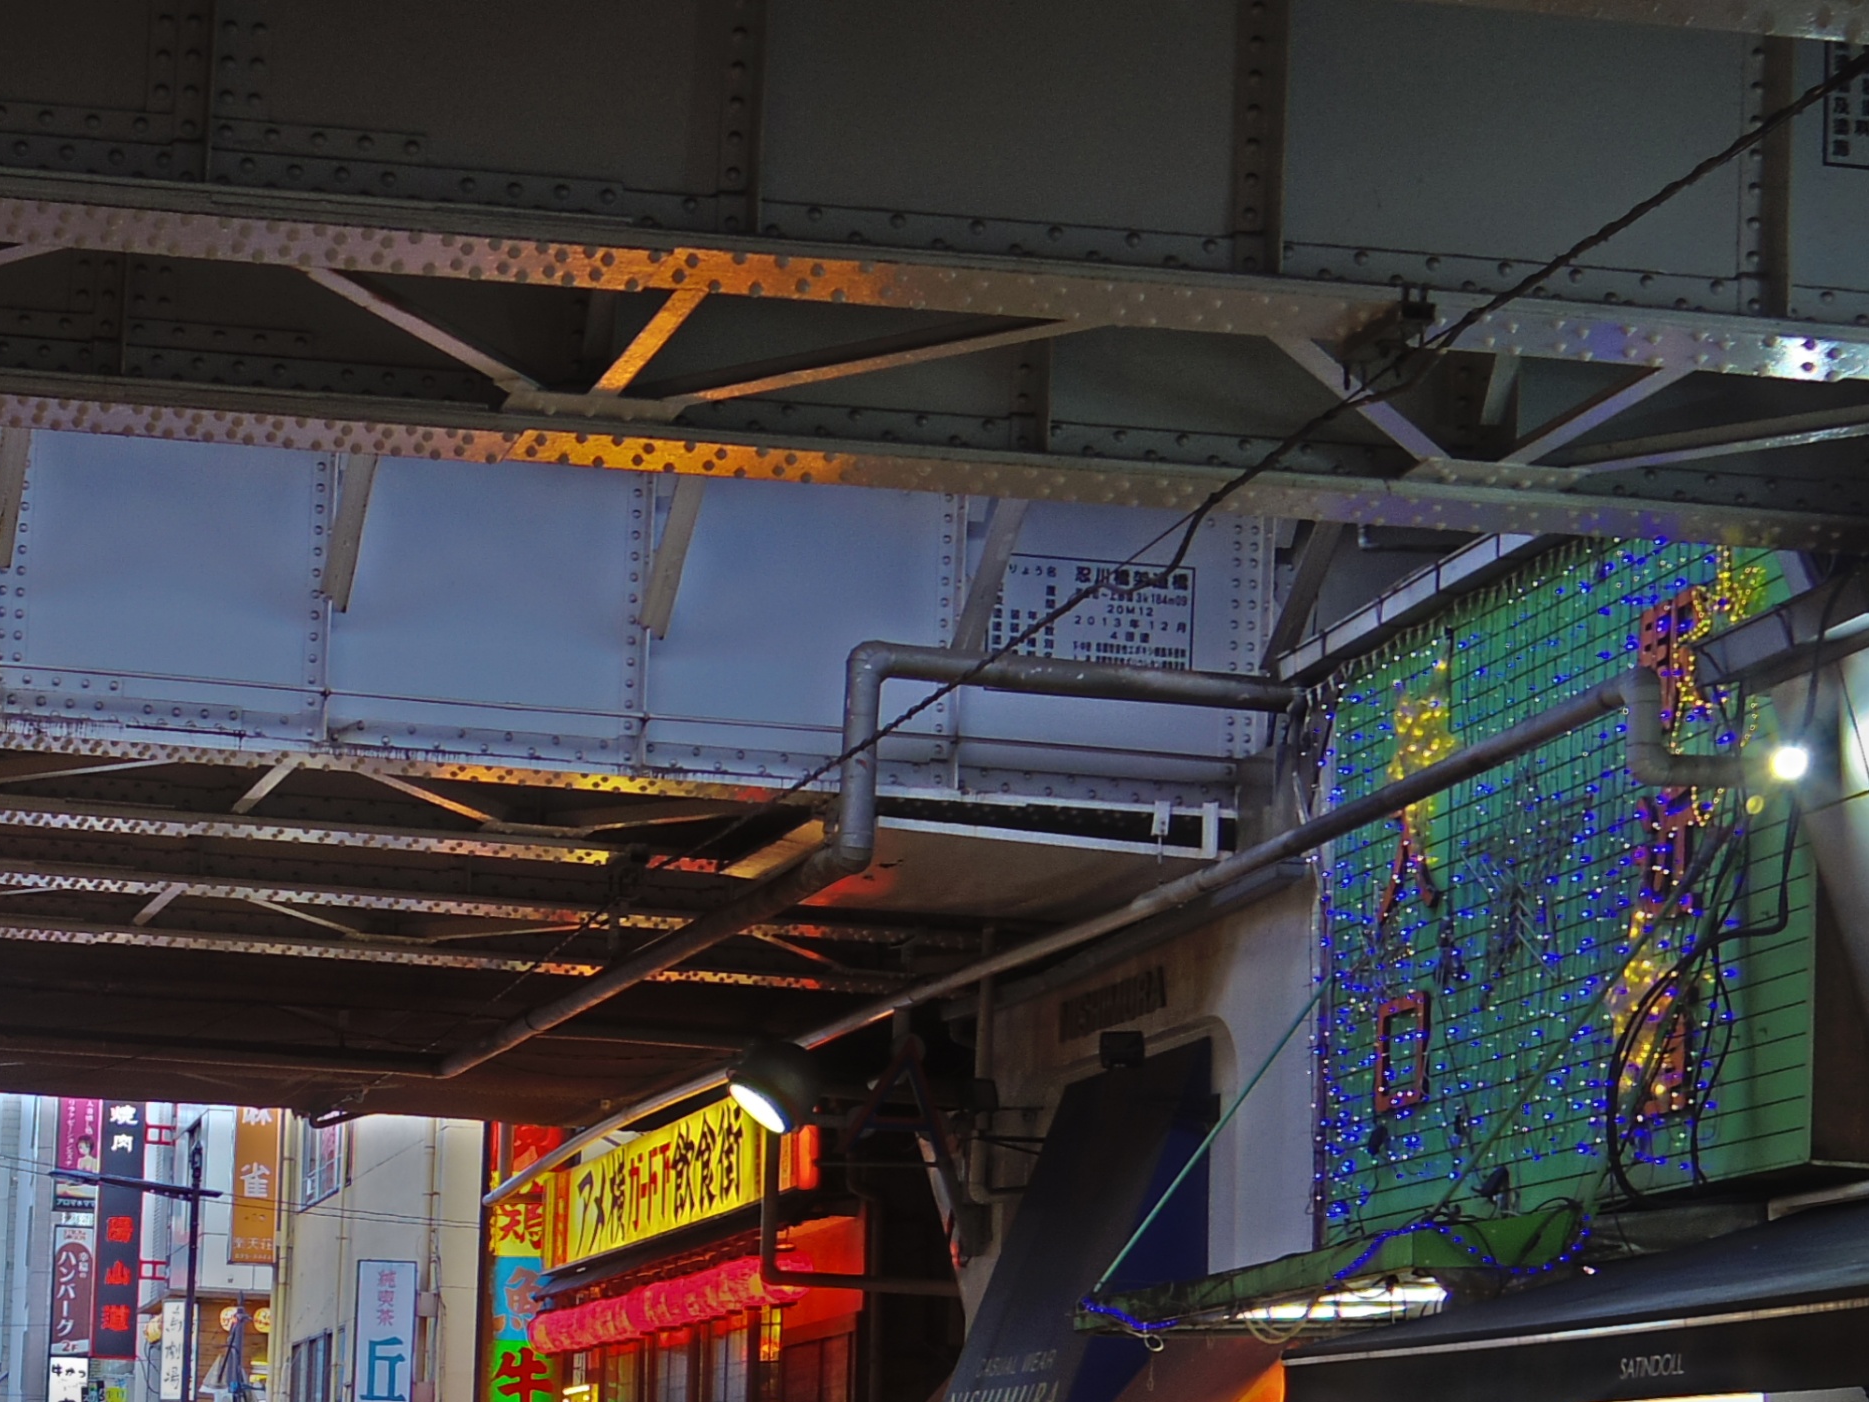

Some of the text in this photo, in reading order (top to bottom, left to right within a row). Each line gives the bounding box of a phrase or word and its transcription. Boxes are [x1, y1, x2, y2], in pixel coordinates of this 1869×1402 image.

[110, 1105, 138, 1153] 焼肉
[57, 1251, 77, 1337] ハンバーグ
[376, 1270, 397, 1326] 純喫茶
[61, 1340, 79, 1352] 2F
[359, 1336, 406, 1402] 丘
[1021, 1349, 1057, 1373] WEAR
